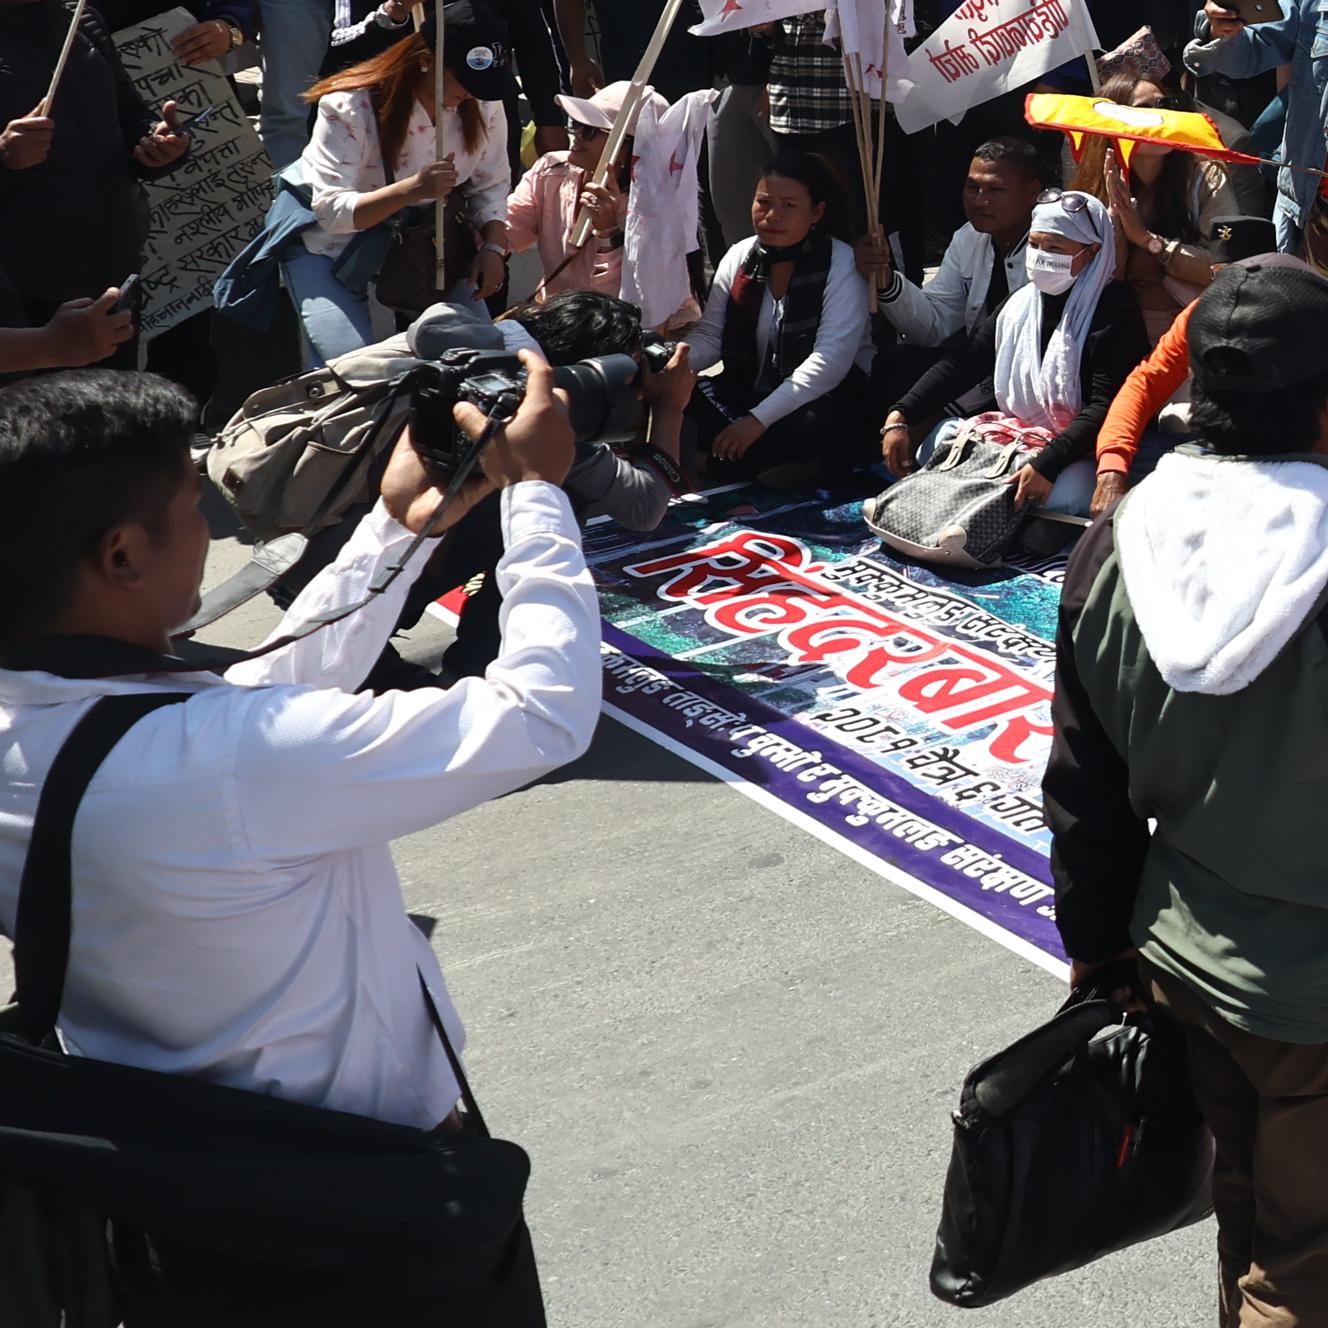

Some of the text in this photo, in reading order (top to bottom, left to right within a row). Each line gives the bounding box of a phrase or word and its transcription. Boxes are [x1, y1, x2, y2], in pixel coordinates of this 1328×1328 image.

[809, 707, 918, 754] २०८१
[906, 746, 980, 786] चैत्र
[955, 781, 1000, 802] ६
[940, 840, 1057, 907] संरक्षण
